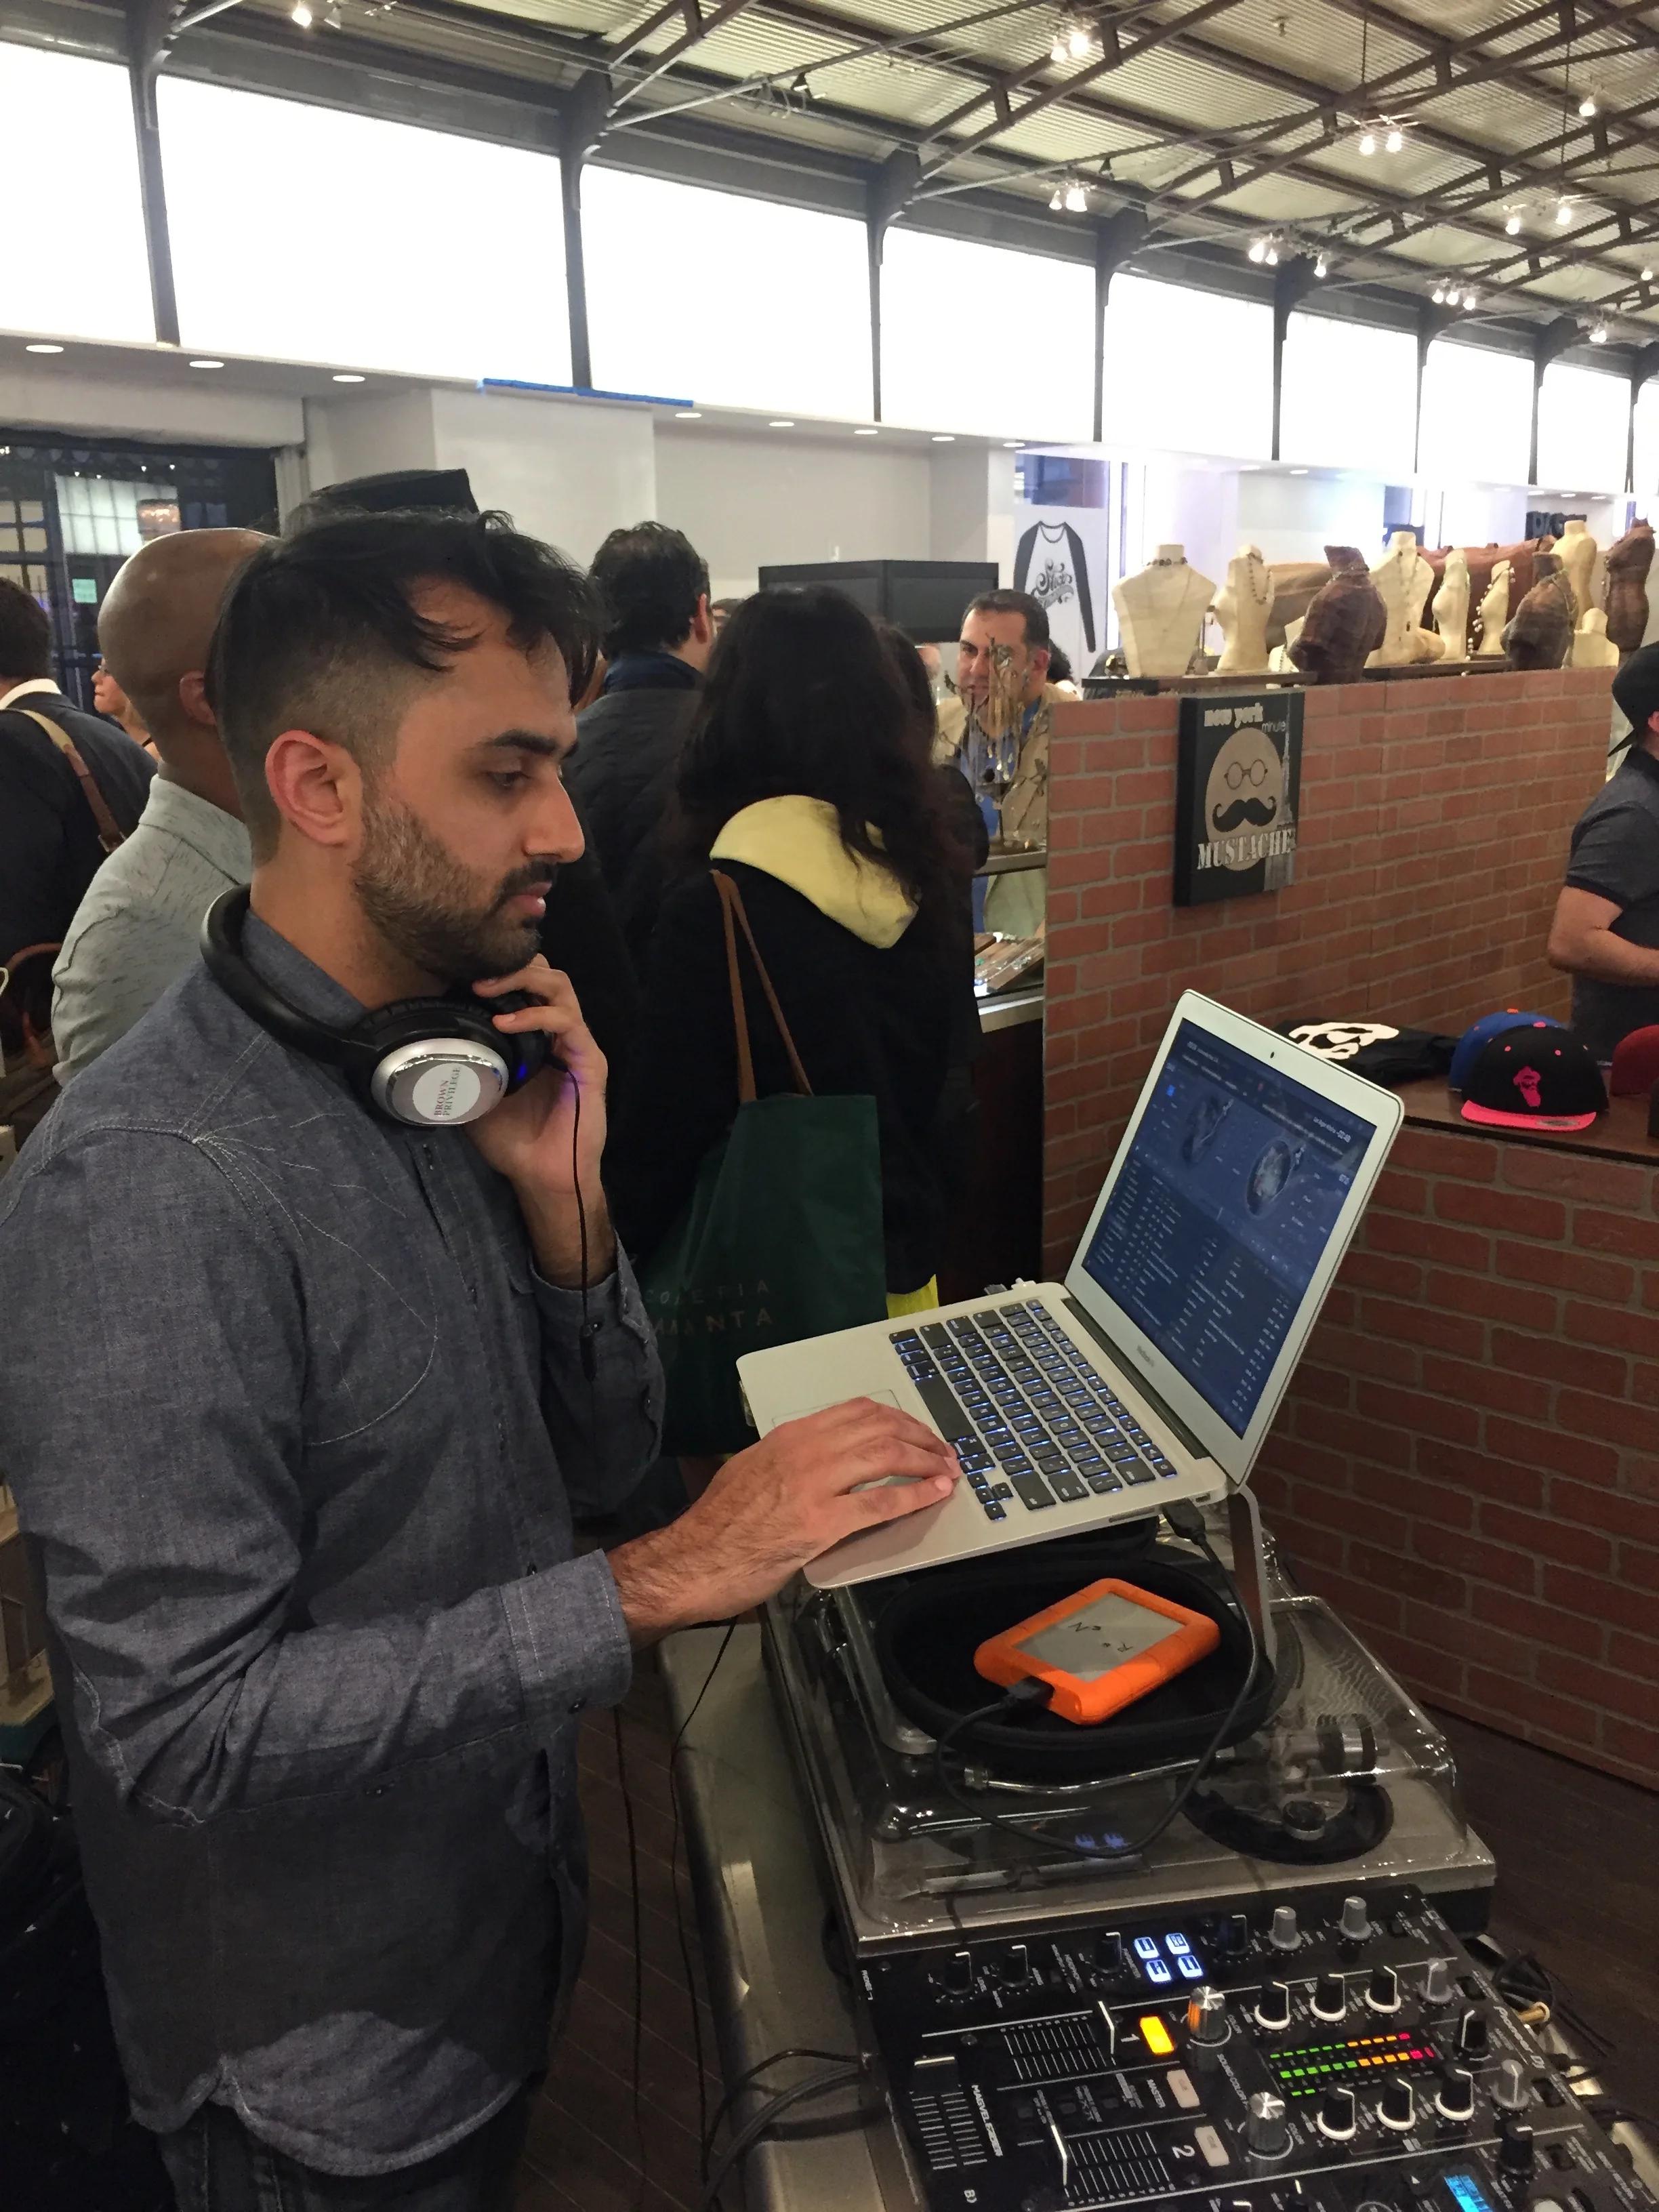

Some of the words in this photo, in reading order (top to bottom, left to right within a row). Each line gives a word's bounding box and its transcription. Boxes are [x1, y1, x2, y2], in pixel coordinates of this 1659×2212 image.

[1197, 828, 1292, 869] MUSTACHE
[434, 1080, 449, 1115] BROWN
[1121, 2034, 1140, 2042] 1
[1147, 2079, 1166, 2108] MASTER
[1229, 2077, 1246, 2100] COLOR
[971, 2085, 989, 2123] MAGVEL
[1288, 2123, 1305, 2144] COLOR
[1172, 2145, 1195, 2158] 2
